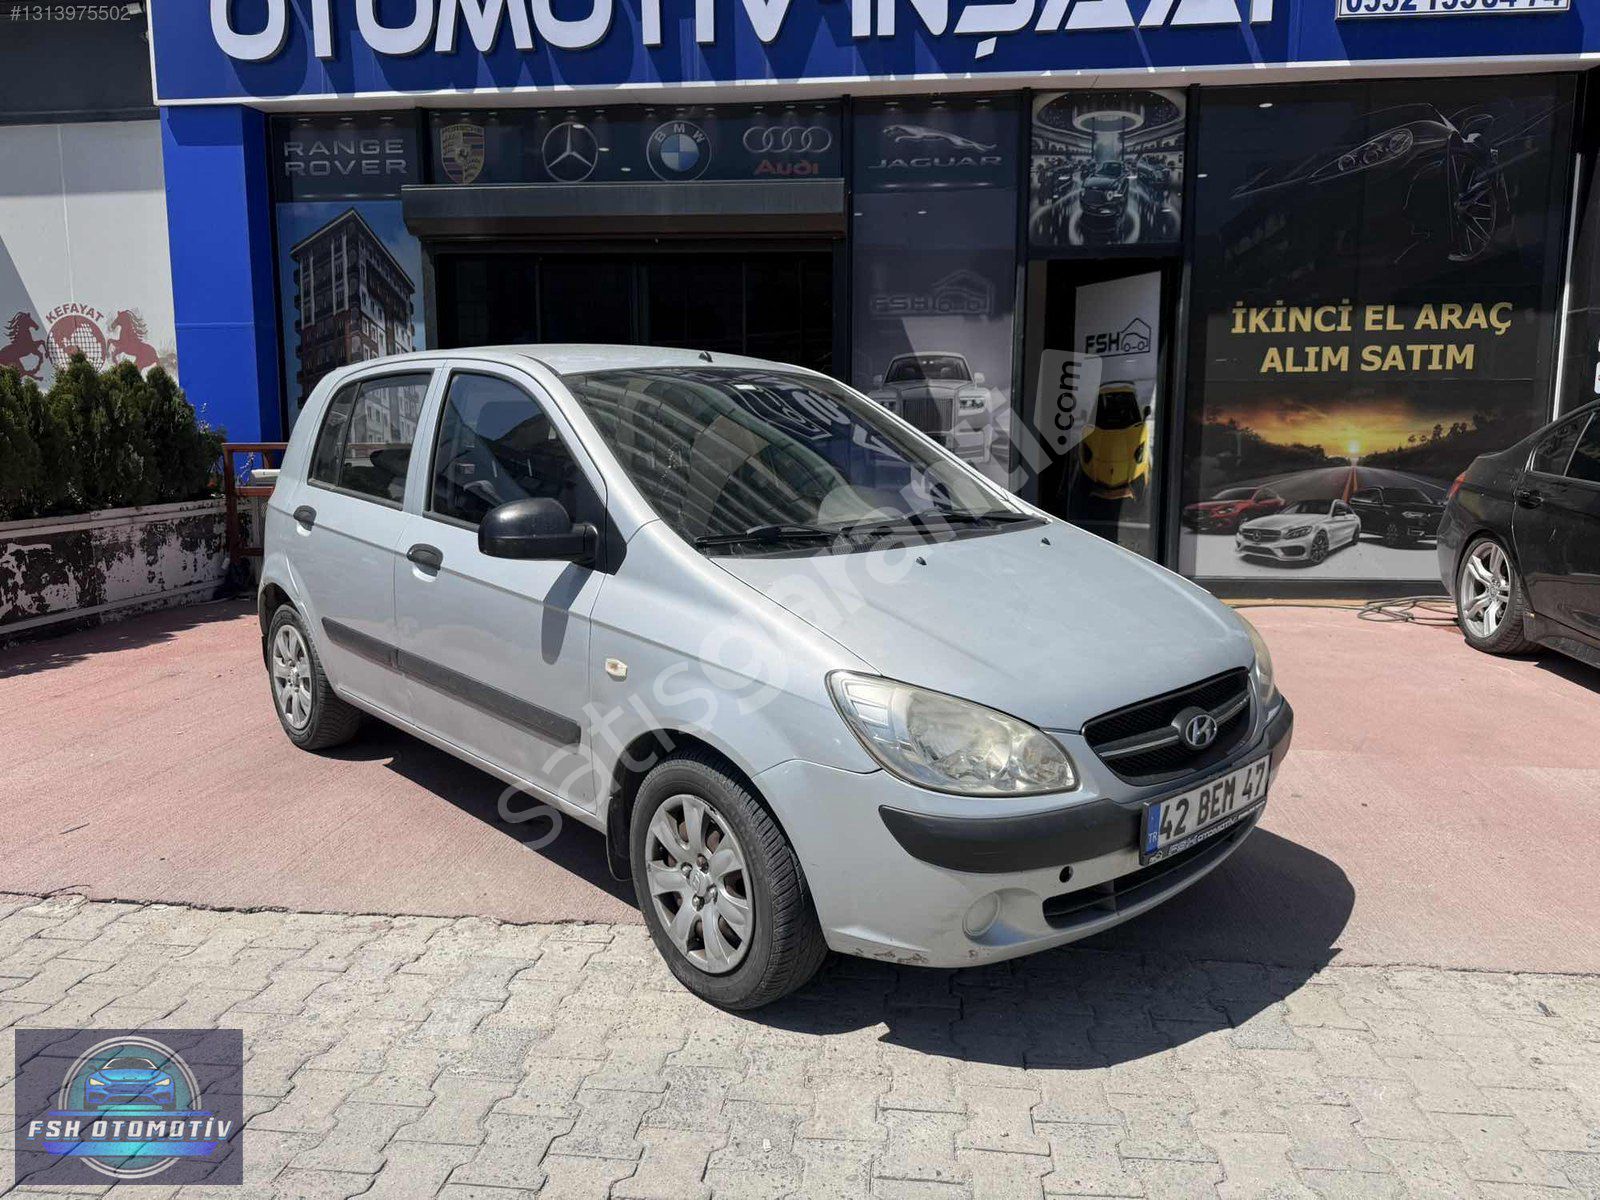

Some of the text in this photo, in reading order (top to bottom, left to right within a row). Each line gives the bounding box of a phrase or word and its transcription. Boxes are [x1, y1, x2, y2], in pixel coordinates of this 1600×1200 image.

[654, 123, 707, 143] BMW
[284, 139, 404, 156] RANGE
[284, 159, 408, 176] ROVER
[868, 156, 1002, 169] JAGUAR
[45, 303, 105, 324] KEFAYAT
[1231, 299, 1513, 336] İKİNCİ EL ARAÇ
[1085, 332, 1121, 353] FSH
[1259, 343, 1475, 373] ALIM SATIM
[1160, 798, 1190, 840] 42
[1197, 776, 1236, 826] BEM
[1242, 761, 1266, 800] 47
[1148, 832, 1159, 845] TR
